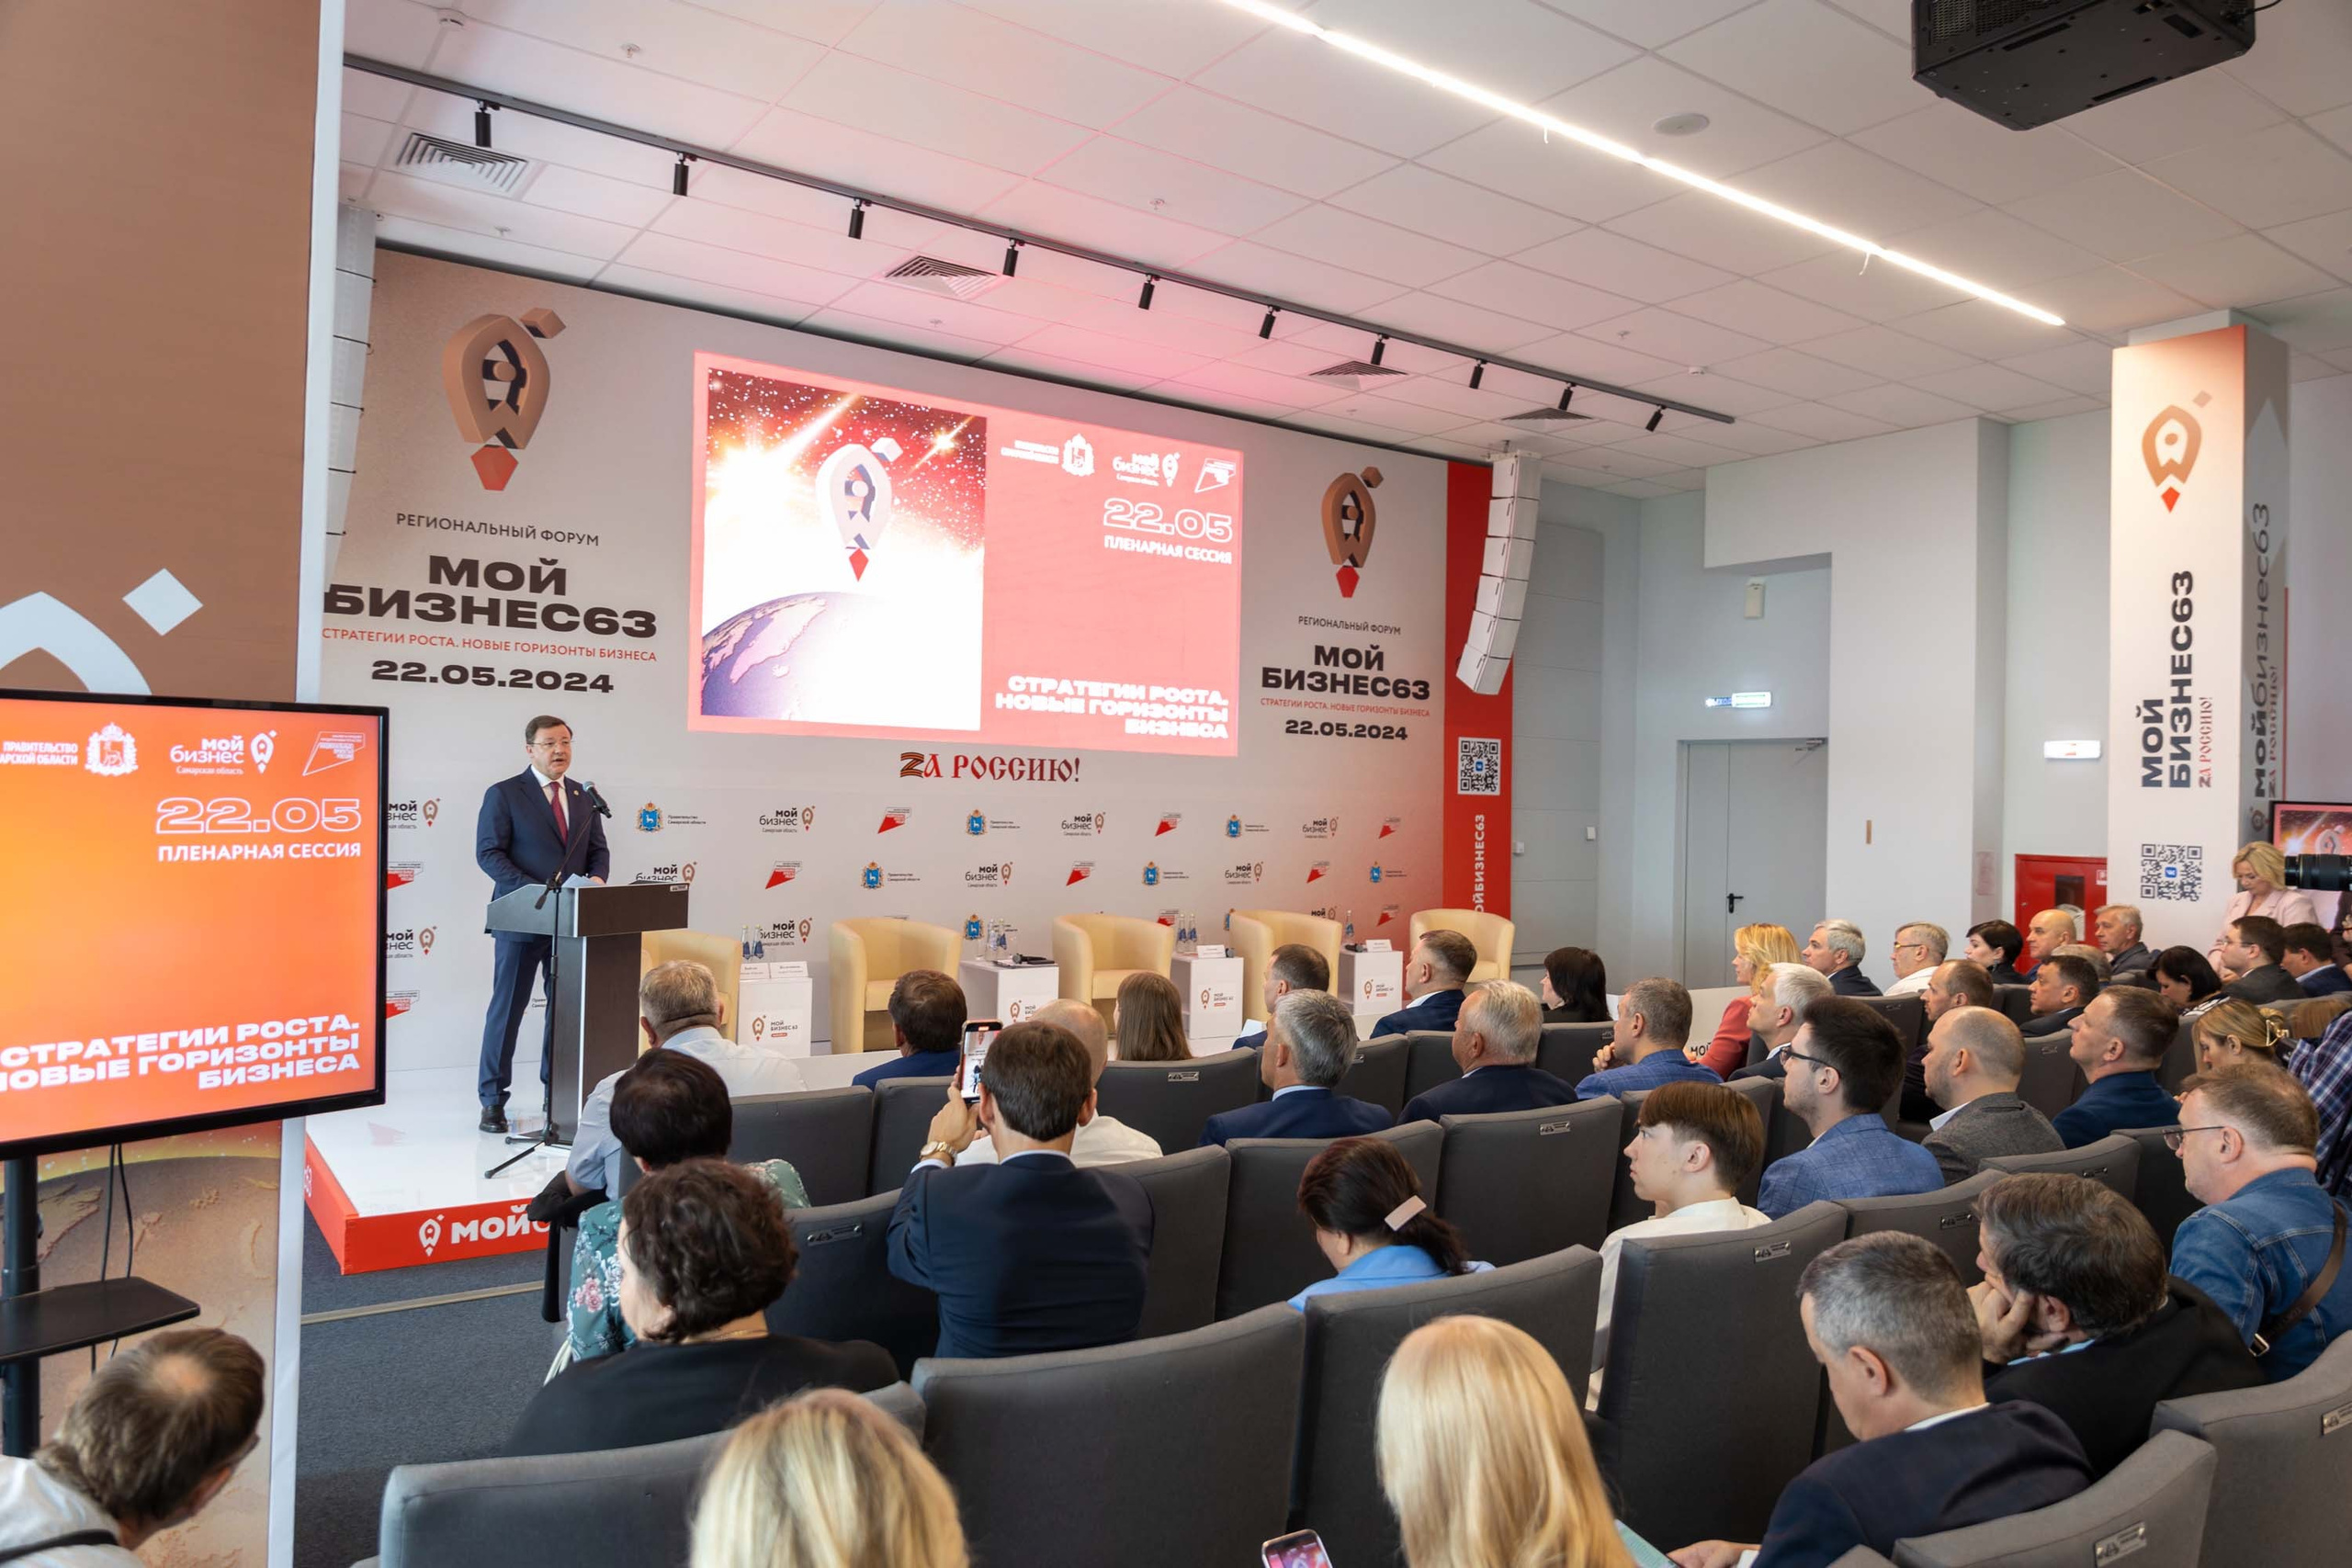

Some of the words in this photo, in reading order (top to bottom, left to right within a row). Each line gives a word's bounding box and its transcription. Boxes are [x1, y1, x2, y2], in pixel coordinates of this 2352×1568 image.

[396, 513, 537, 540] РЕГИОНАЛЬНЫЙ
[539, 531, 599, 547] ФОРУМ
[1102, 497, 1233, 543] 22.05
[1104, 536, 1183, 558] ПЛЕНАРНАЯ
[1184, 545, 1232, 565] СЕССИЯ
[429, 555, 567, 596] МОЙ
[323, 583, 657, 638] БИЗНЕС63
[1298, 615, 1369, 632] РЕГИОНАЛЬНЫЙ
[1370, 624, 1401, 636] ФОРУМ
[322, 627, 405, 644] СТРАТЕГИИ
[462, 637, 511, 652] НОВЫЕ
[514, 642, 596, 658] ГОРИЗОНТЫ
[599, 648, 657, 661] БИЗНЕСА
[1314, 644, 1385, 671] МОЙ
[371, 660, 614, 694] 22.05.2024
[1008, 675, 1145, 701] СТРАТЕГИИ
[1261, 667, 1430, 701] БИЗНЕС63
[2169, 570, 2194, 788] БИЗНЕС63
[995, 693, 1085, 715] НОВЫЕ
[1089, 699, 1228, 723] ГОРИЗОНТЫ
[1260, 697, 1303, 709] СТРАТЕГИИ
[1330, 703, 1355, 713] НОВЫЕ
[1356, 705, 1399, 716] ГОРИЗОНТЫ
[1400, 706, 1430, 717] БИЗНЕСА
[1125, 718, 1228, 739] БИЗНЕСА
[1285, 719, 1408, 740] 22.05.2024
[3, 740, 78, 753] ПРАВИТЕЛЬСТВО
[170, 745, 244, 764] бизнес
[201, 736, 244, 750] мой
[2136, 699, 2164, 788] МОЙ
[0, 752, 36, 765] АРСКОЙ
[37, 753, 78, 765] ОБЛАСТИ
[951, 754, 1080, 783] РОССИЮ!
[155, 796, 361, 834] 22.05
[387, 812, 417, 821] знес
[389, 800, 417, 812] мой
[775, 807, 797, 818] мой
[759, 815, 797, 826] бизнес
[1061, 820, 1091, 829] бизнес
[1074, 814, 1091, 823] мой
[158, 843, 284, 862] ПЛЕНАРНАЯ
[288, 842, 361, 859] СЕССИЯ
[1473, 814, 1485, 913] ОЙБИЗНЕС63
[653, 863, 678, 874] мой
[965, 872, 998, 882] бизнес
[978, 863, 998, 874] мой
[773, 919, 795, 931] мой
[0, 1024, 232, 1068] СТРАТЕГИИ
[138, 1033, 359, 1075] ГОРИЗОНТЫ
[198, 1054, 360, 1090] БИЗНЕСА
